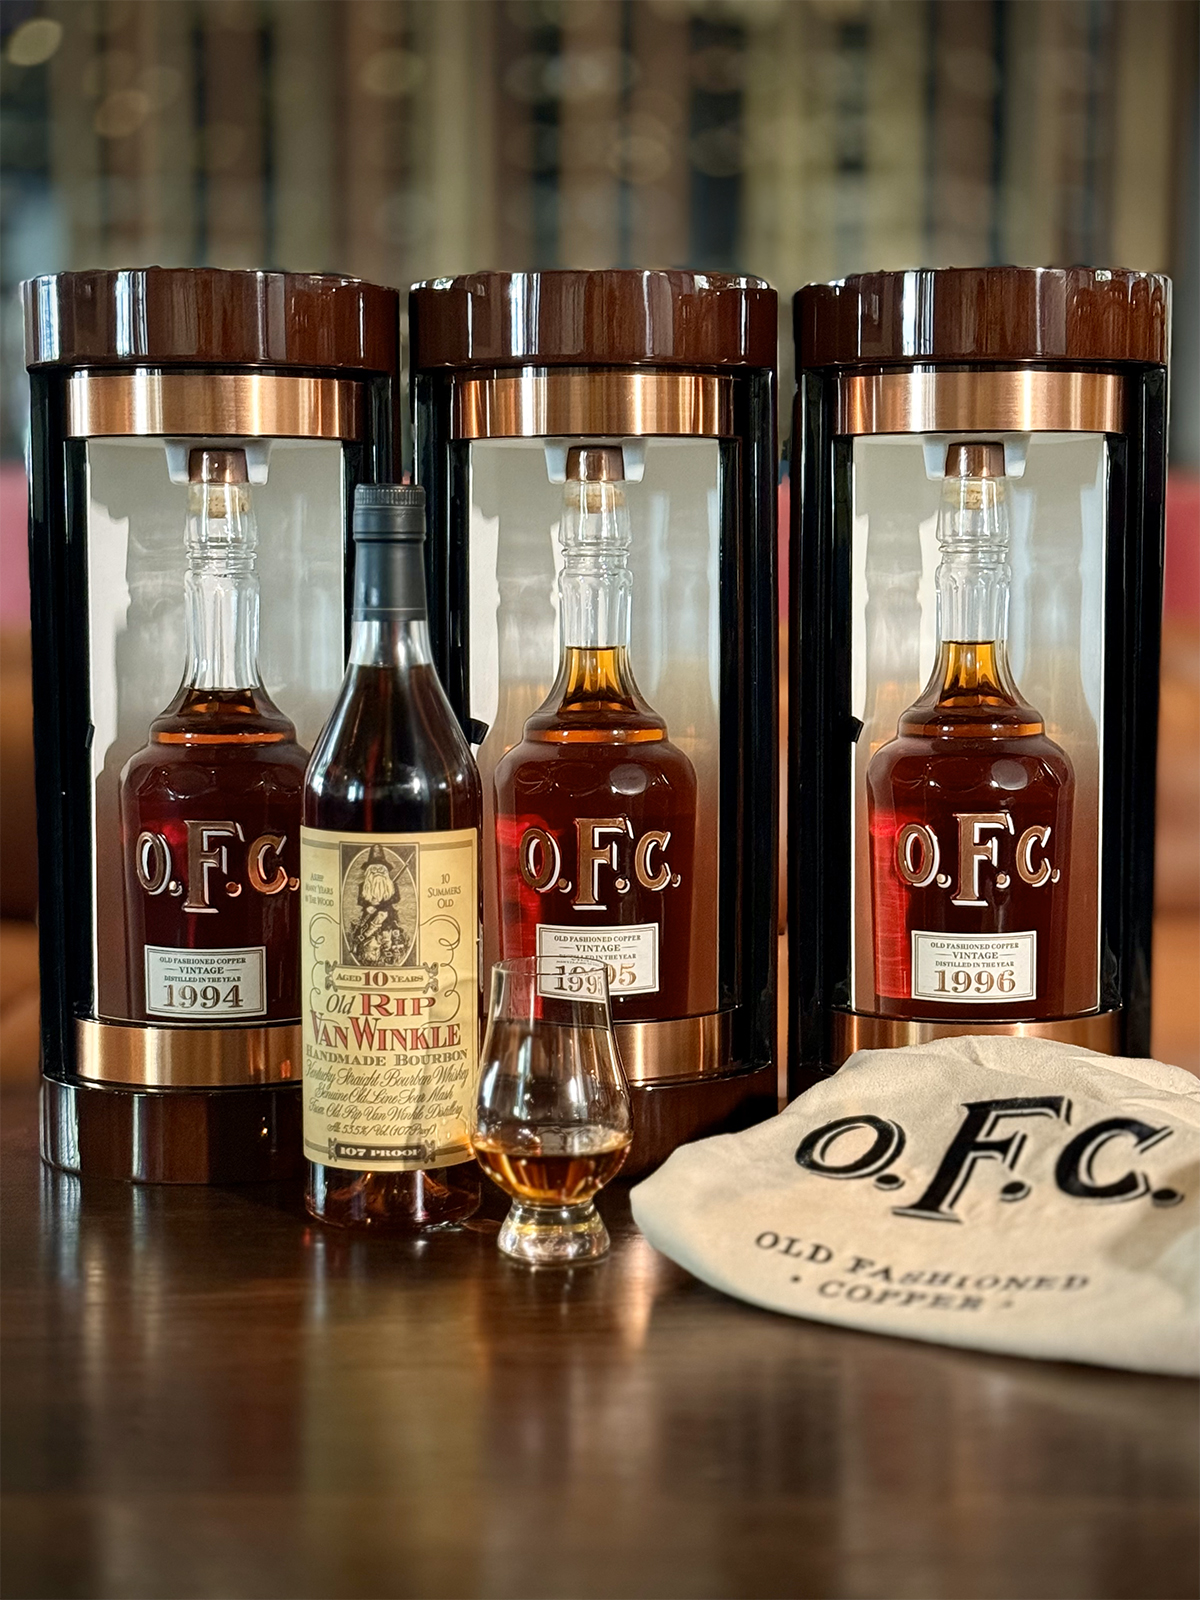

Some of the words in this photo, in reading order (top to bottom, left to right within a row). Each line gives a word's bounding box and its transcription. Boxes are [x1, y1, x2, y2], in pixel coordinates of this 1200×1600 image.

[136, 820, 300, 914] O.F.C.
[519, 816, 682, 911] O.F.C.
[894, 812, 1060, 907] O.F.C.
[440, 873, 450, 884] 10
[427, 885, 462, 899] SUMMERS
[437, 898, 454, 909] OLD
[575, 944, 621, 952] VINTAGE
[946, 942, 990, 950] FASHIONED
[991, 942, 1020, 950] COPPER
[952, 951, 999, 960] VINTAGE
[159, 956, 173, 964] OLD
[179, 966, 225, 975] VINTAGE
[935, 960, 972, 968] DISTILLED
[996, 960, 1015, 968] YEAR
[336, 973, 362, 983] AGED
[362, 970, 389, 987] 10
[390, 974, 424, 983] YEARS
[933, 970, 1016, 994] 1996
[163, 984, 244, 1009] 1994
[326, 994, 356, 1015] Old
[359, 993, 436, 1017] RIP
[310, 1010, 350, 1051] VAN
[348, 1016, 461, 1052] WINKLE
[306, 1044, 386, 1066] HANDMADE
[394, 1048, 468, 1066] BOURBON
[336, 1067, 381, 1090] Straight
[380, 1068, 432, 1088] Bourbon
[348, 1086, 372, 1104] Old
[426, 1084, 455, 1103] Mash
[326, 1102, 344, 1118] Old
[342, 1104, 362, 1124] Rip
[363, 1106, 387, 1122] Van
[340, 1147, 367, 1157] 107
[370, 1149, 421, 1158] PROOF
[795, 1095, 1185, 1224] O.F.C.
[755, 1231, 833, 1265] OLD
[846, 1256, 1090, 1292] FASHIONED
[817, 1279, 986, 1312] COPPER
